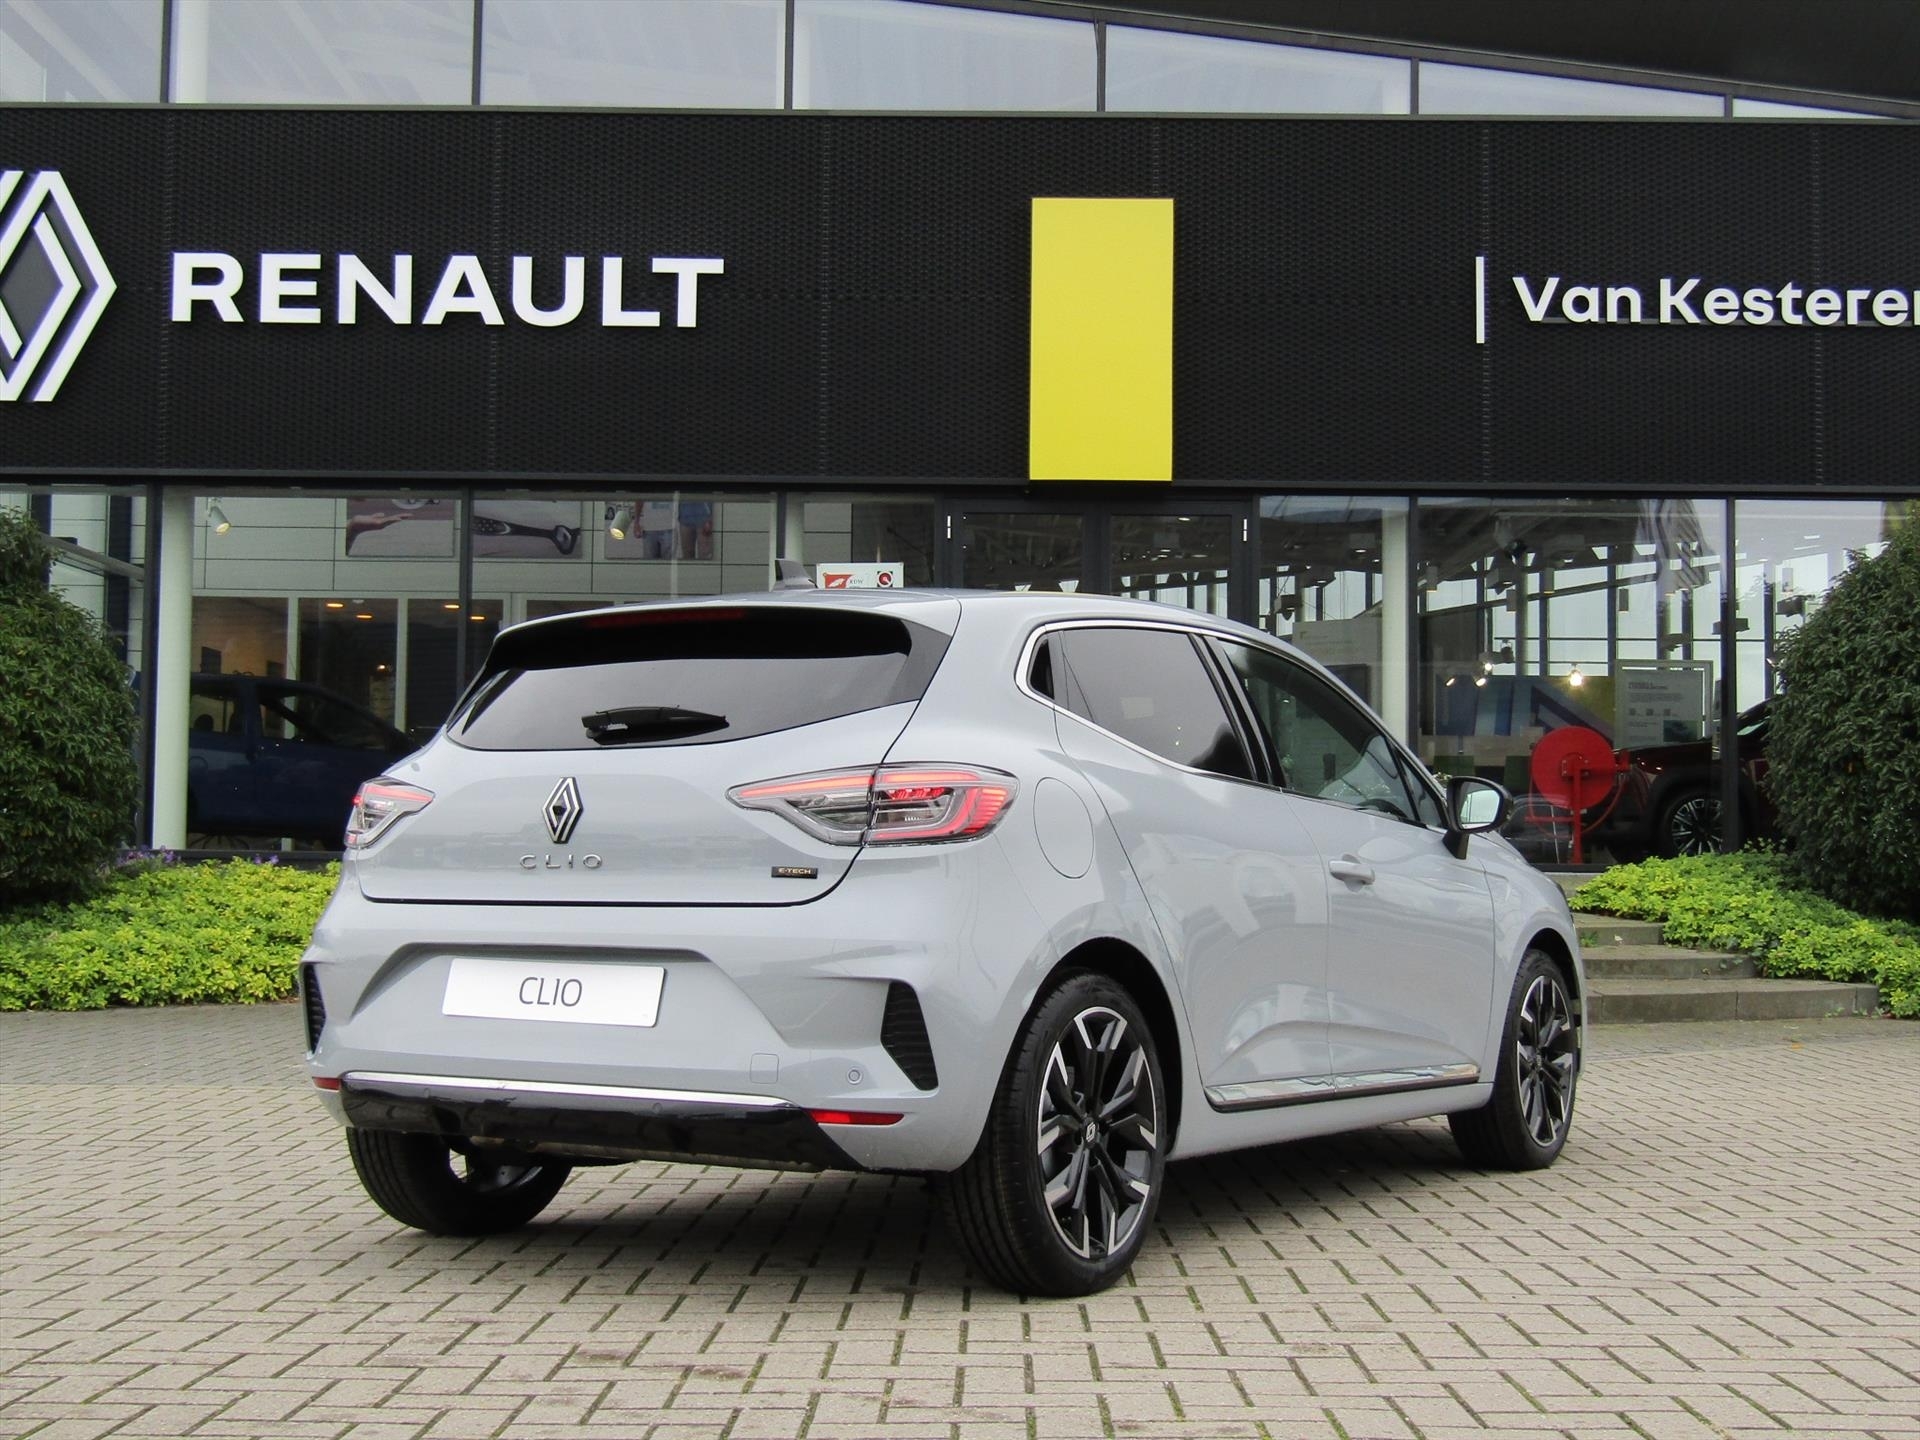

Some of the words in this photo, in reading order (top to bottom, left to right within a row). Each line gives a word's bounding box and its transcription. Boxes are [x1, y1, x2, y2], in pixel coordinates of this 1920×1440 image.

[171, 252, 724, 328] RENAULT
[1512, 276, 1641, 323] Van
[1659, 278, 1920, 326] Kestere
[520, 854, 602, 870] CLIO
[778, 867, 812, 875] E-TECH
[519, 977, 583, 1007] CLIO
